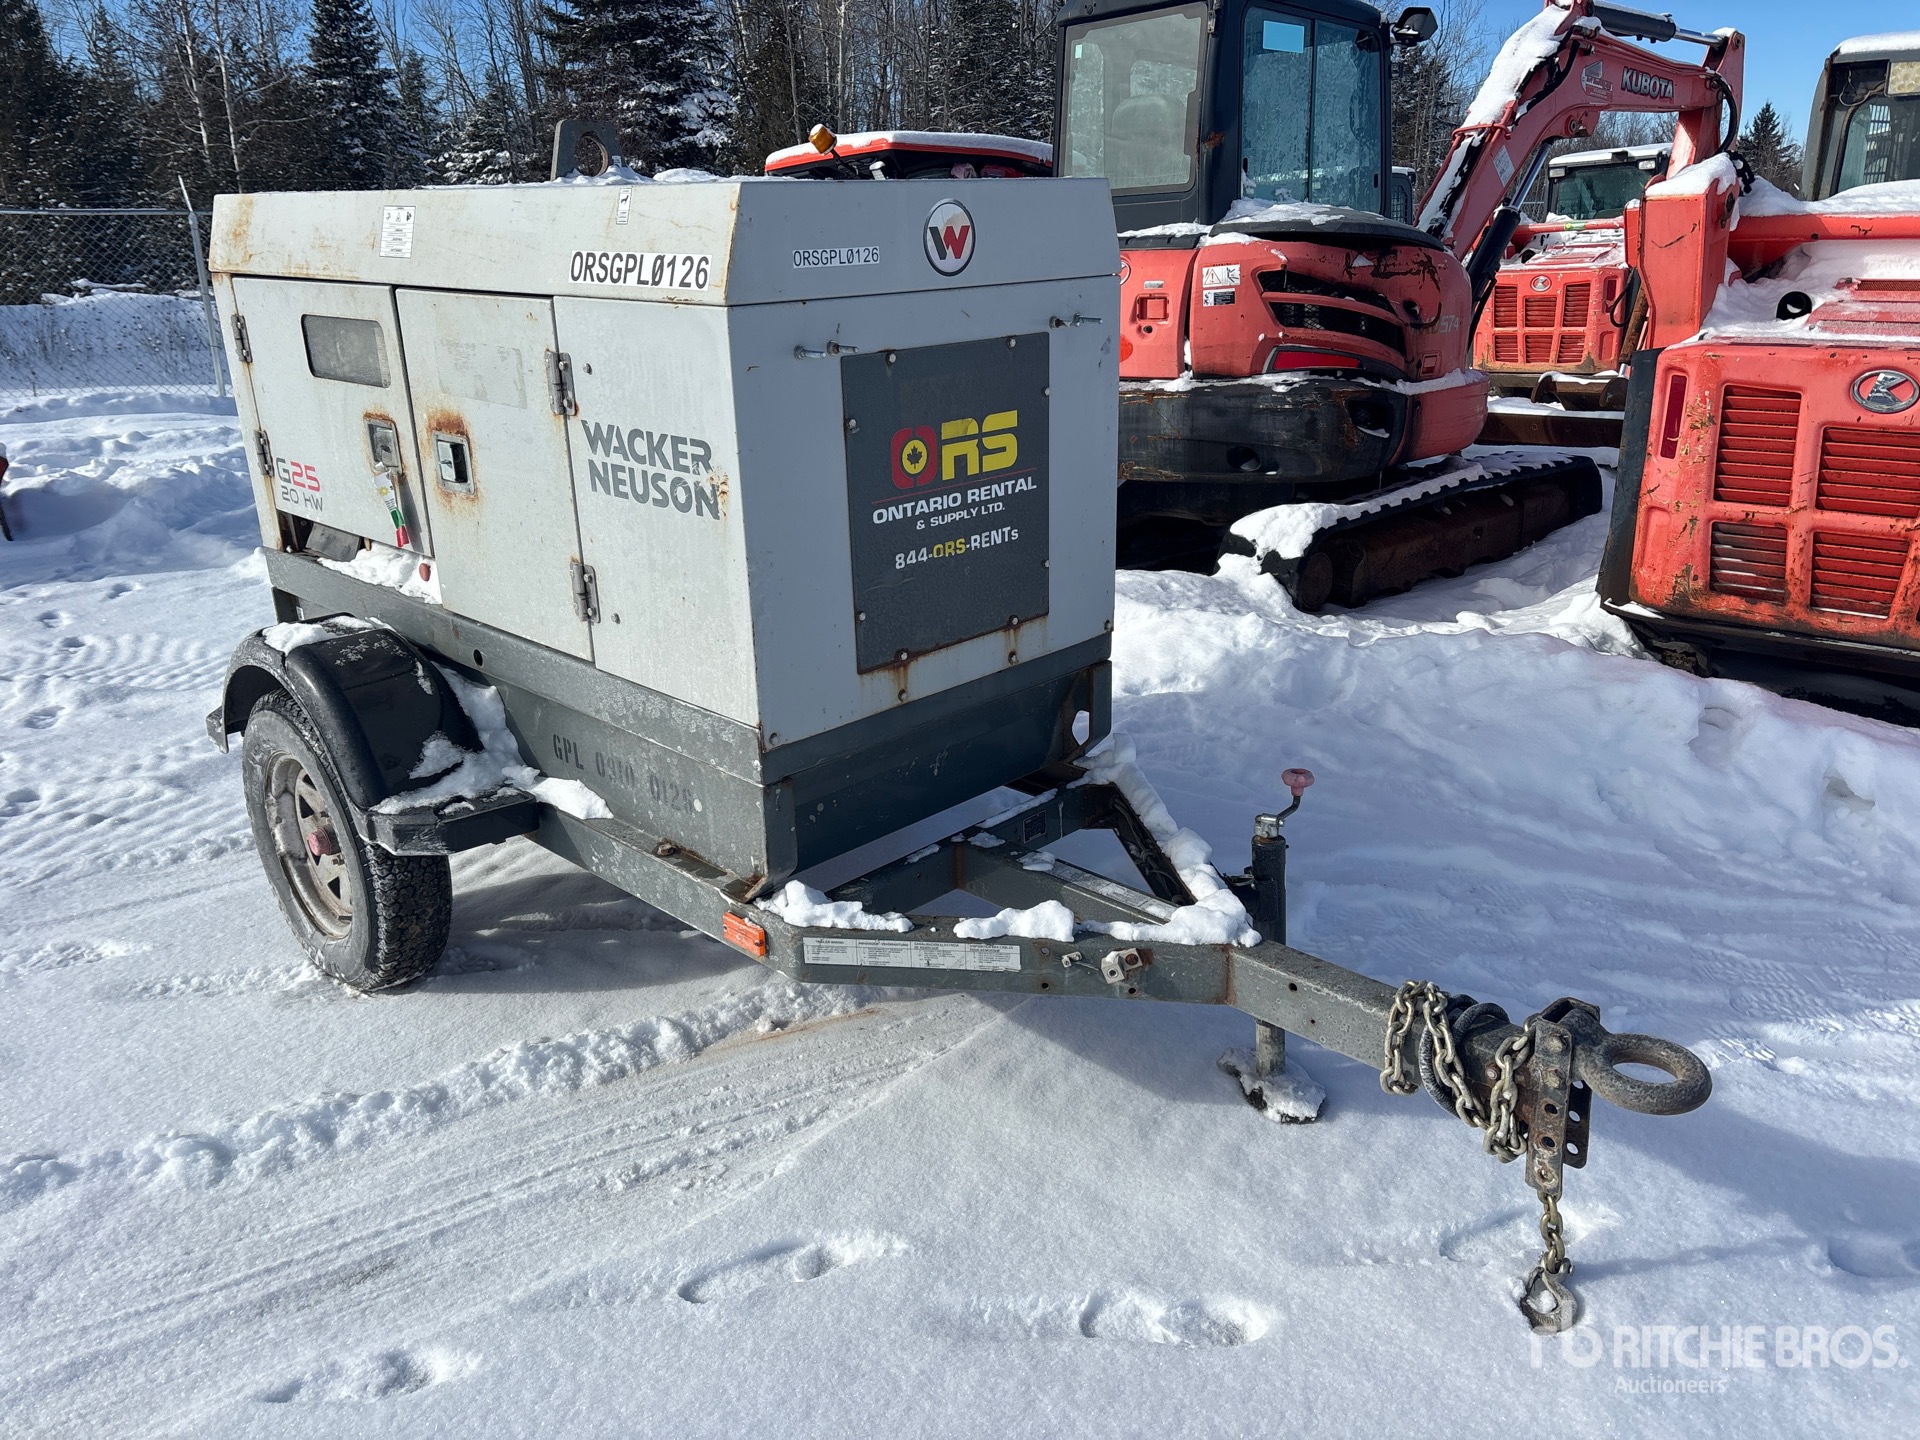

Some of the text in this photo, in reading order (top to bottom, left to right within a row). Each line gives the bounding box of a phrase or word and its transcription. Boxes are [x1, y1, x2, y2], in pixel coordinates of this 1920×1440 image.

[1621, 66, 1673, 99] KUBOTA
[581, 419, 713, 476] WACKER
[891, 410, 1017, 489] ORS
[276, 457, 320, 492] G25
[588, 459, 720, 520] NEUSON
[281, 485, 299, 504] 20
[872, 476, 1037, 524] ONTARIO RENTAL
[916, 502, 1005, 530] & SUPPLY LTD.
[552, 733, 584, 771] GPL
